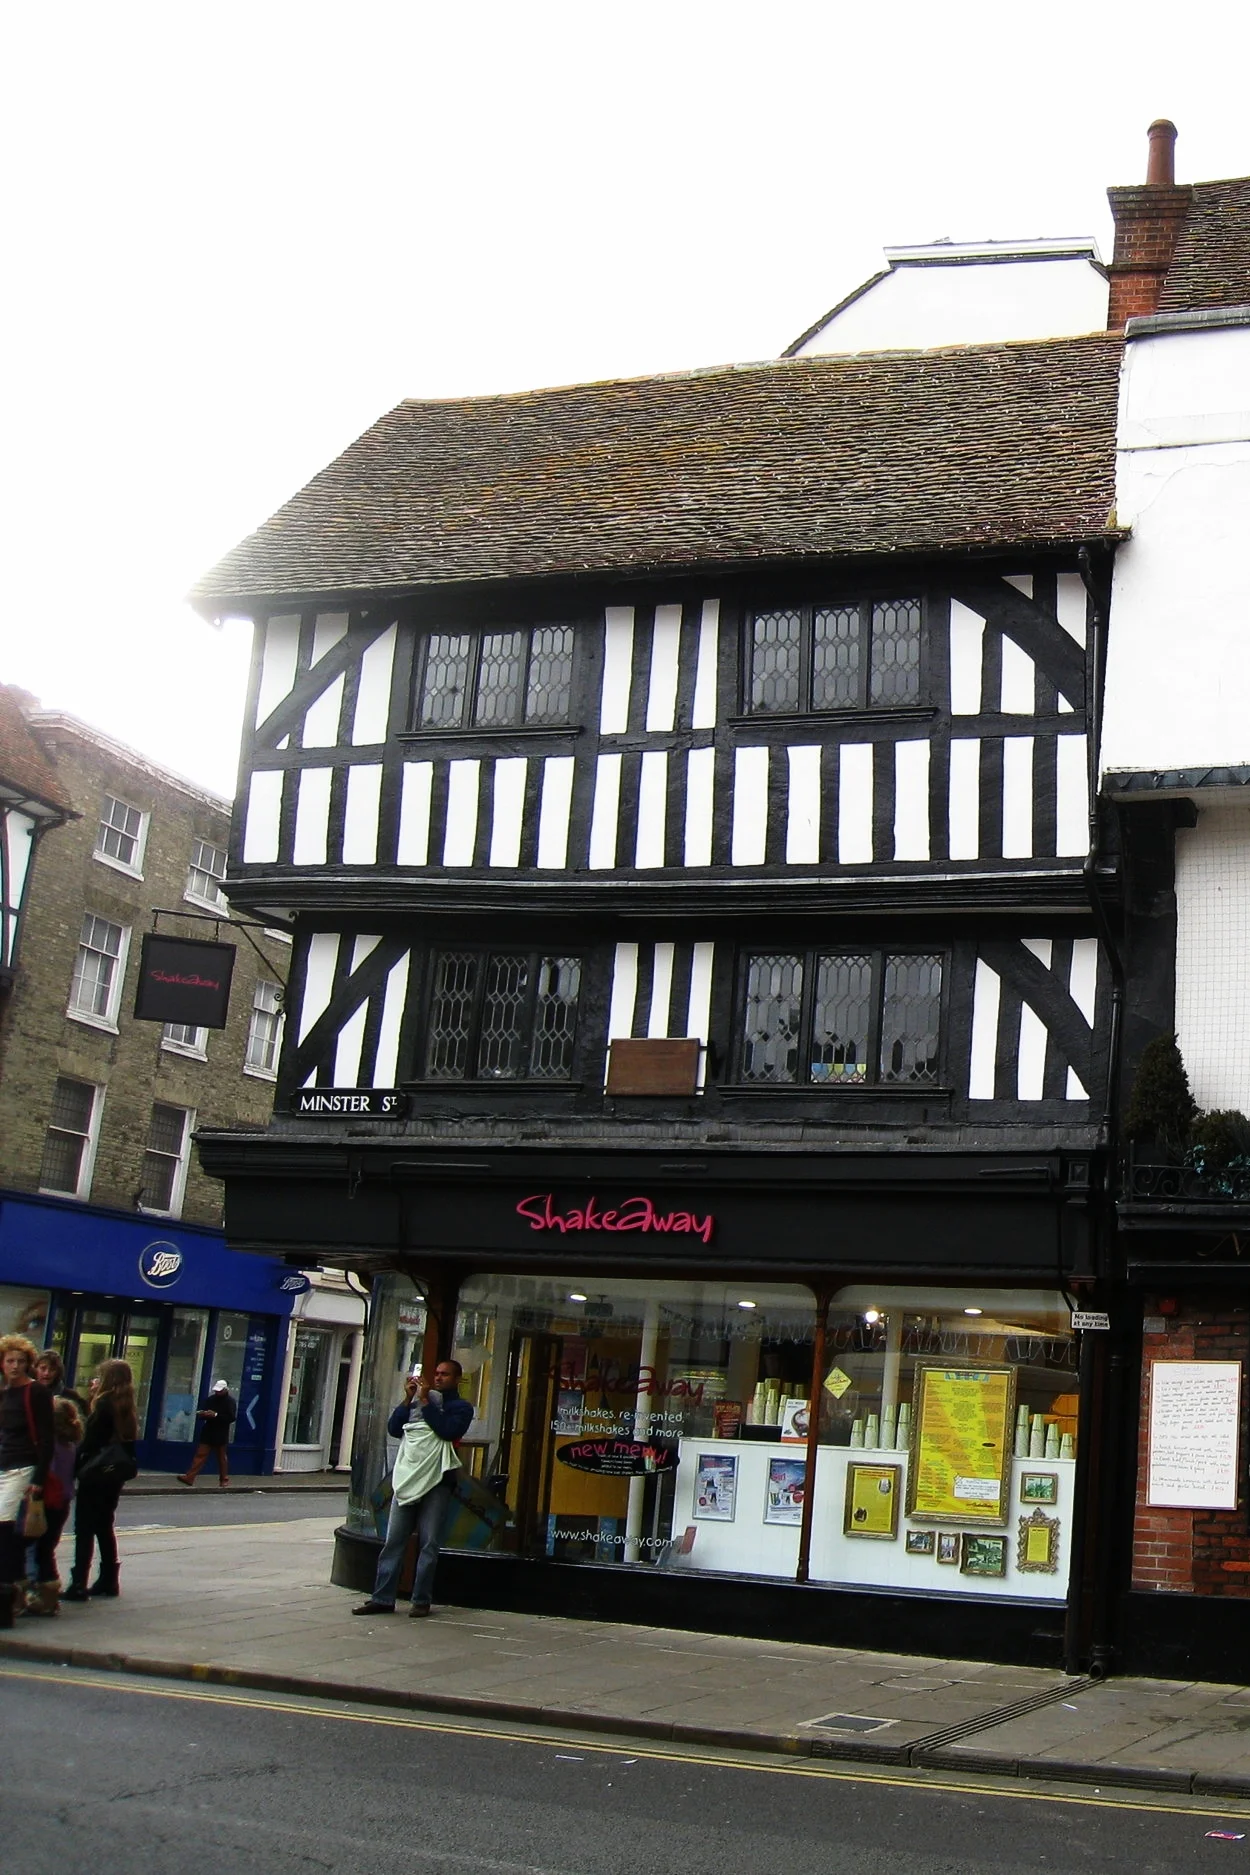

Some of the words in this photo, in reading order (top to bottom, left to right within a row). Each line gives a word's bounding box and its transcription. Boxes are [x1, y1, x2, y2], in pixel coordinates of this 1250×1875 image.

[300, 1095, 370, 1112] MINSTER
[147, 1251, 182, 1277] Boots
[575, 1423, 630, 1435] milkshakes
[655, 1429, 684, 1438] more
[569, 1441, 608, 1459] new
[551, 1529, 673, 1548] www.shakeaway.com
